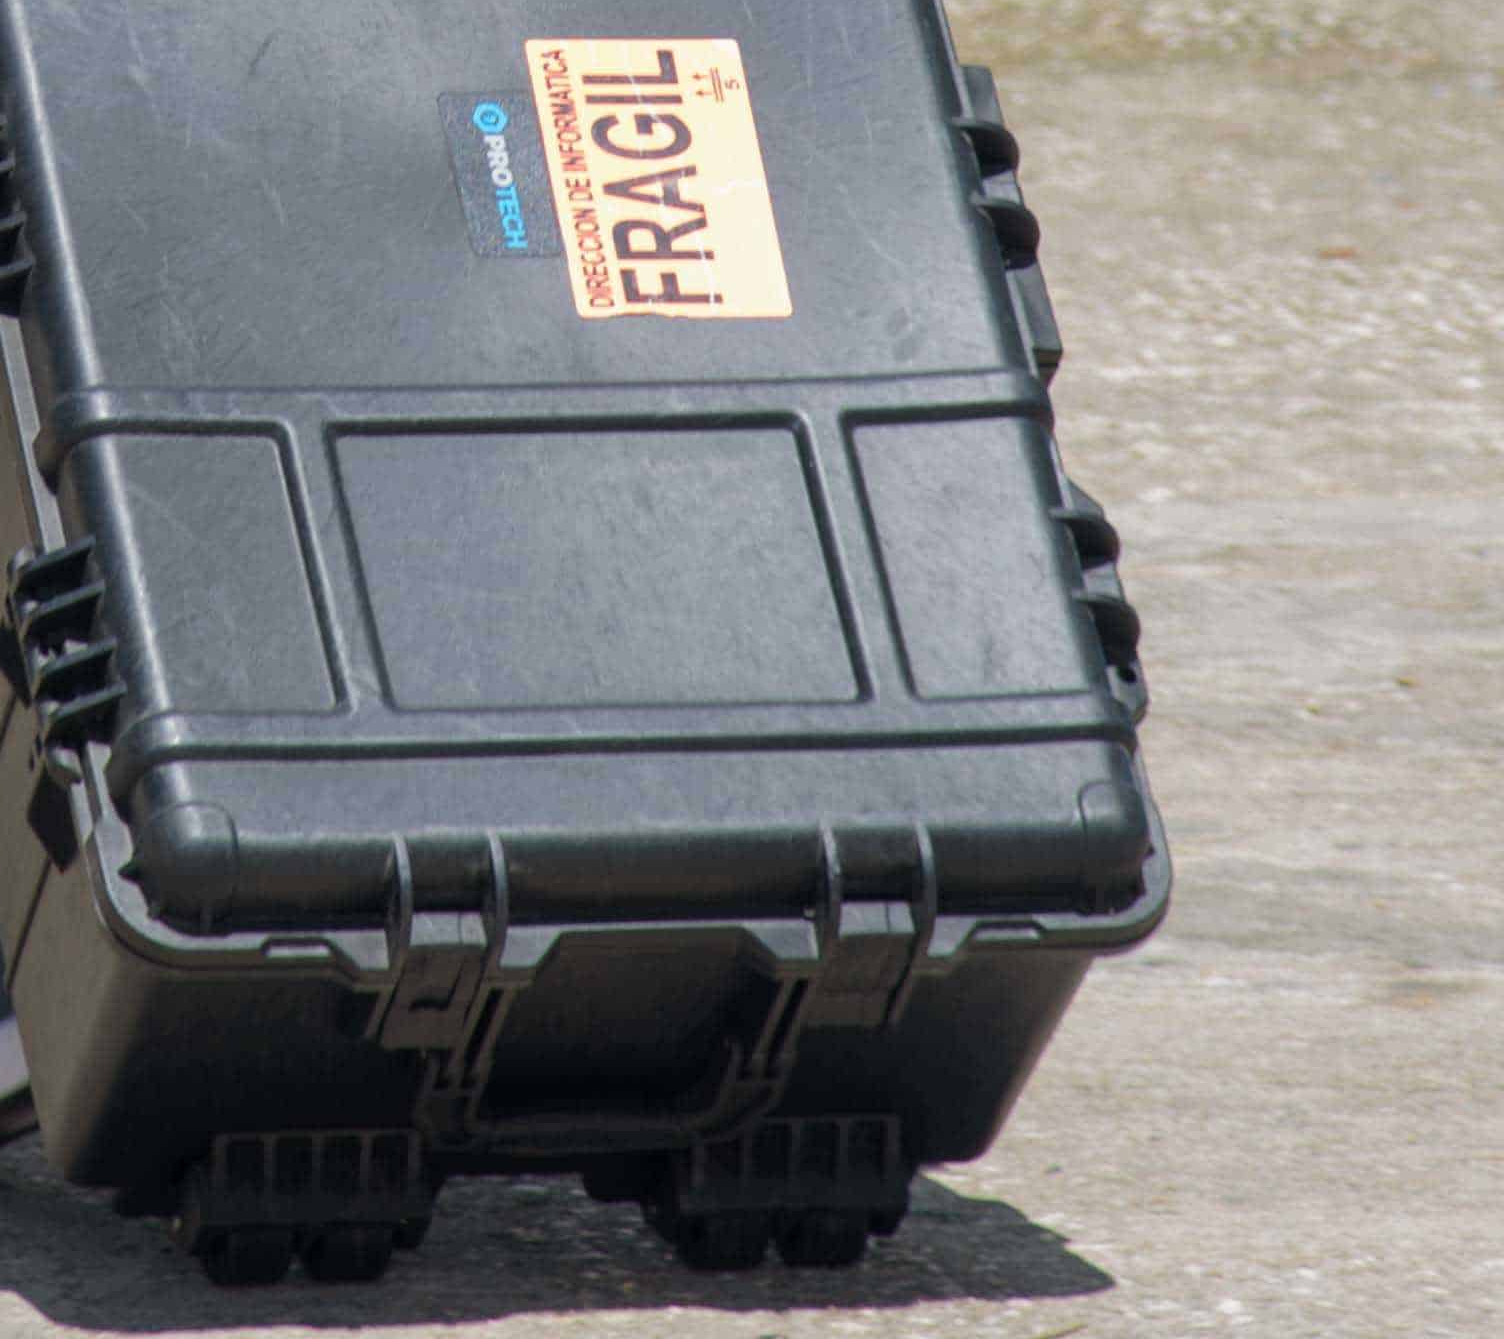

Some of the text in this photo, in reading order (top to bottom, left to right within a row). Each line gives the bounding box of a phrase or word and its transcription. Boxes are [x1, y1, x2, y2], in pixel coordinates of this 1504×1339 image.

[483, 134, 528, 249] PROTECH
[542, 50, 615, 307] DIRECCION DE INFORMATICA
[582, 50, 723, 303] FRAGIL
